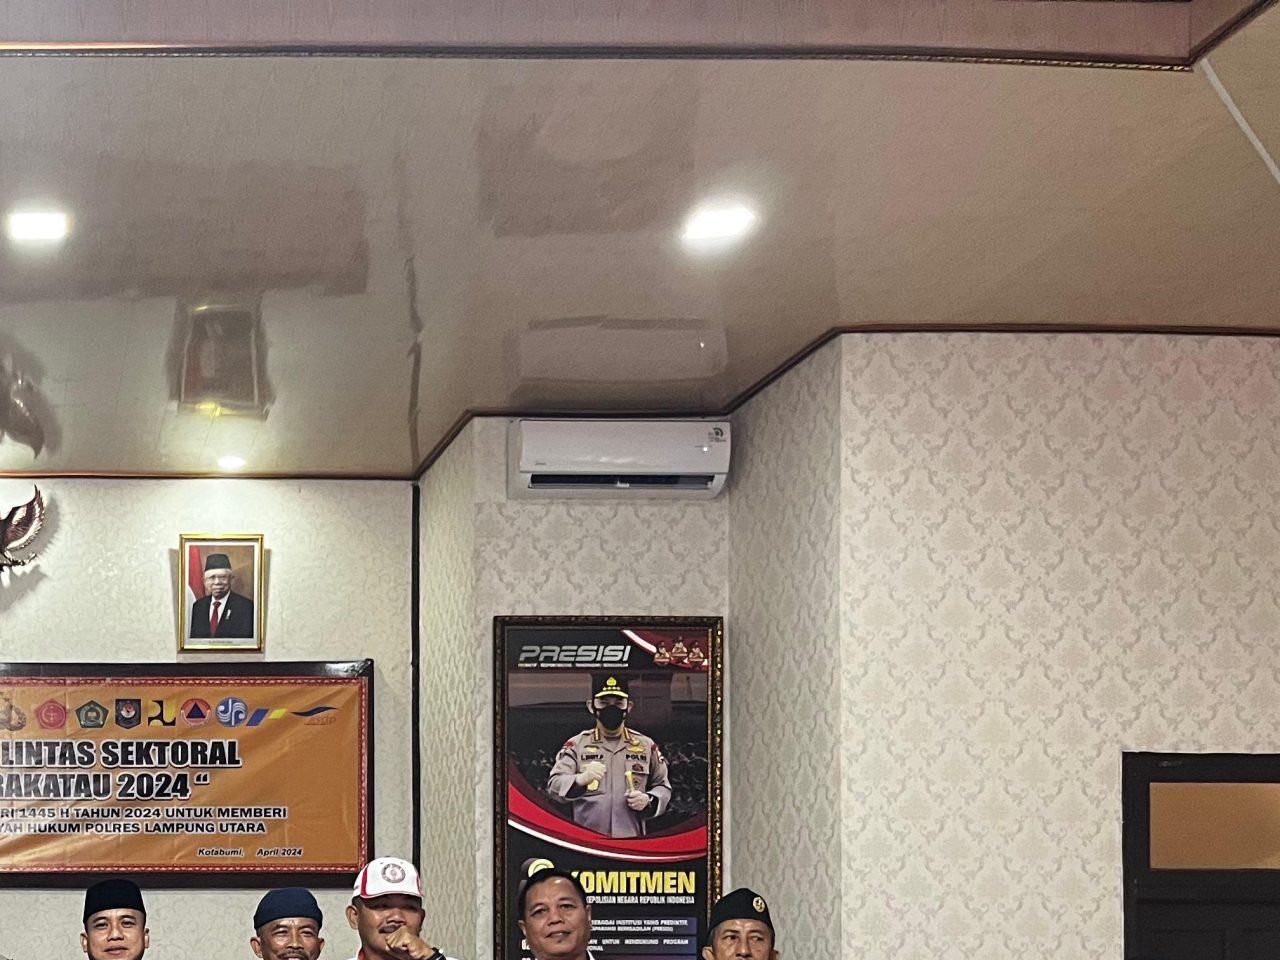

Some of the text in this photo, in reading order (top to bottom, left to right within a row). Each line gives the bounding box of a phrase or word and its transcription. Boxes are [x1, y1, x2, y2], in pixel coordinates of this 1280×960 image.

[519, 645, 631, 661] PRESISI
[1, 740, 96, 766] LINTAS
[101, 740, 241, 766] SEKTORAL
[117, 773, 190, 799] 2024
[19, 808, 56, 818] 1445
[60, 808, 70, 818] H
[73, 808, 121, 818] TAHUN
[124, 808, 161, 818] 2024
[165, 808, 212, 818] UNTUK
[217, 808, 287, 818] MEMBERI
[27, 823, 81, 833] HUKUM
[85, 823, 140, 833] POLRES
[144, 823, 215, 833] LAMPUNG
[219, 823, 266, 833] UTARA
[257, 848, 278, 857] April
[281, 848, 303, 856] 2024
[571, 871, 696, 894] OMITMEN
[617, 896, 639, 904] NEGARA
[640, 896, 666, 904] REPUBLIK
[666, 896, 695, 904] INDONESIA
